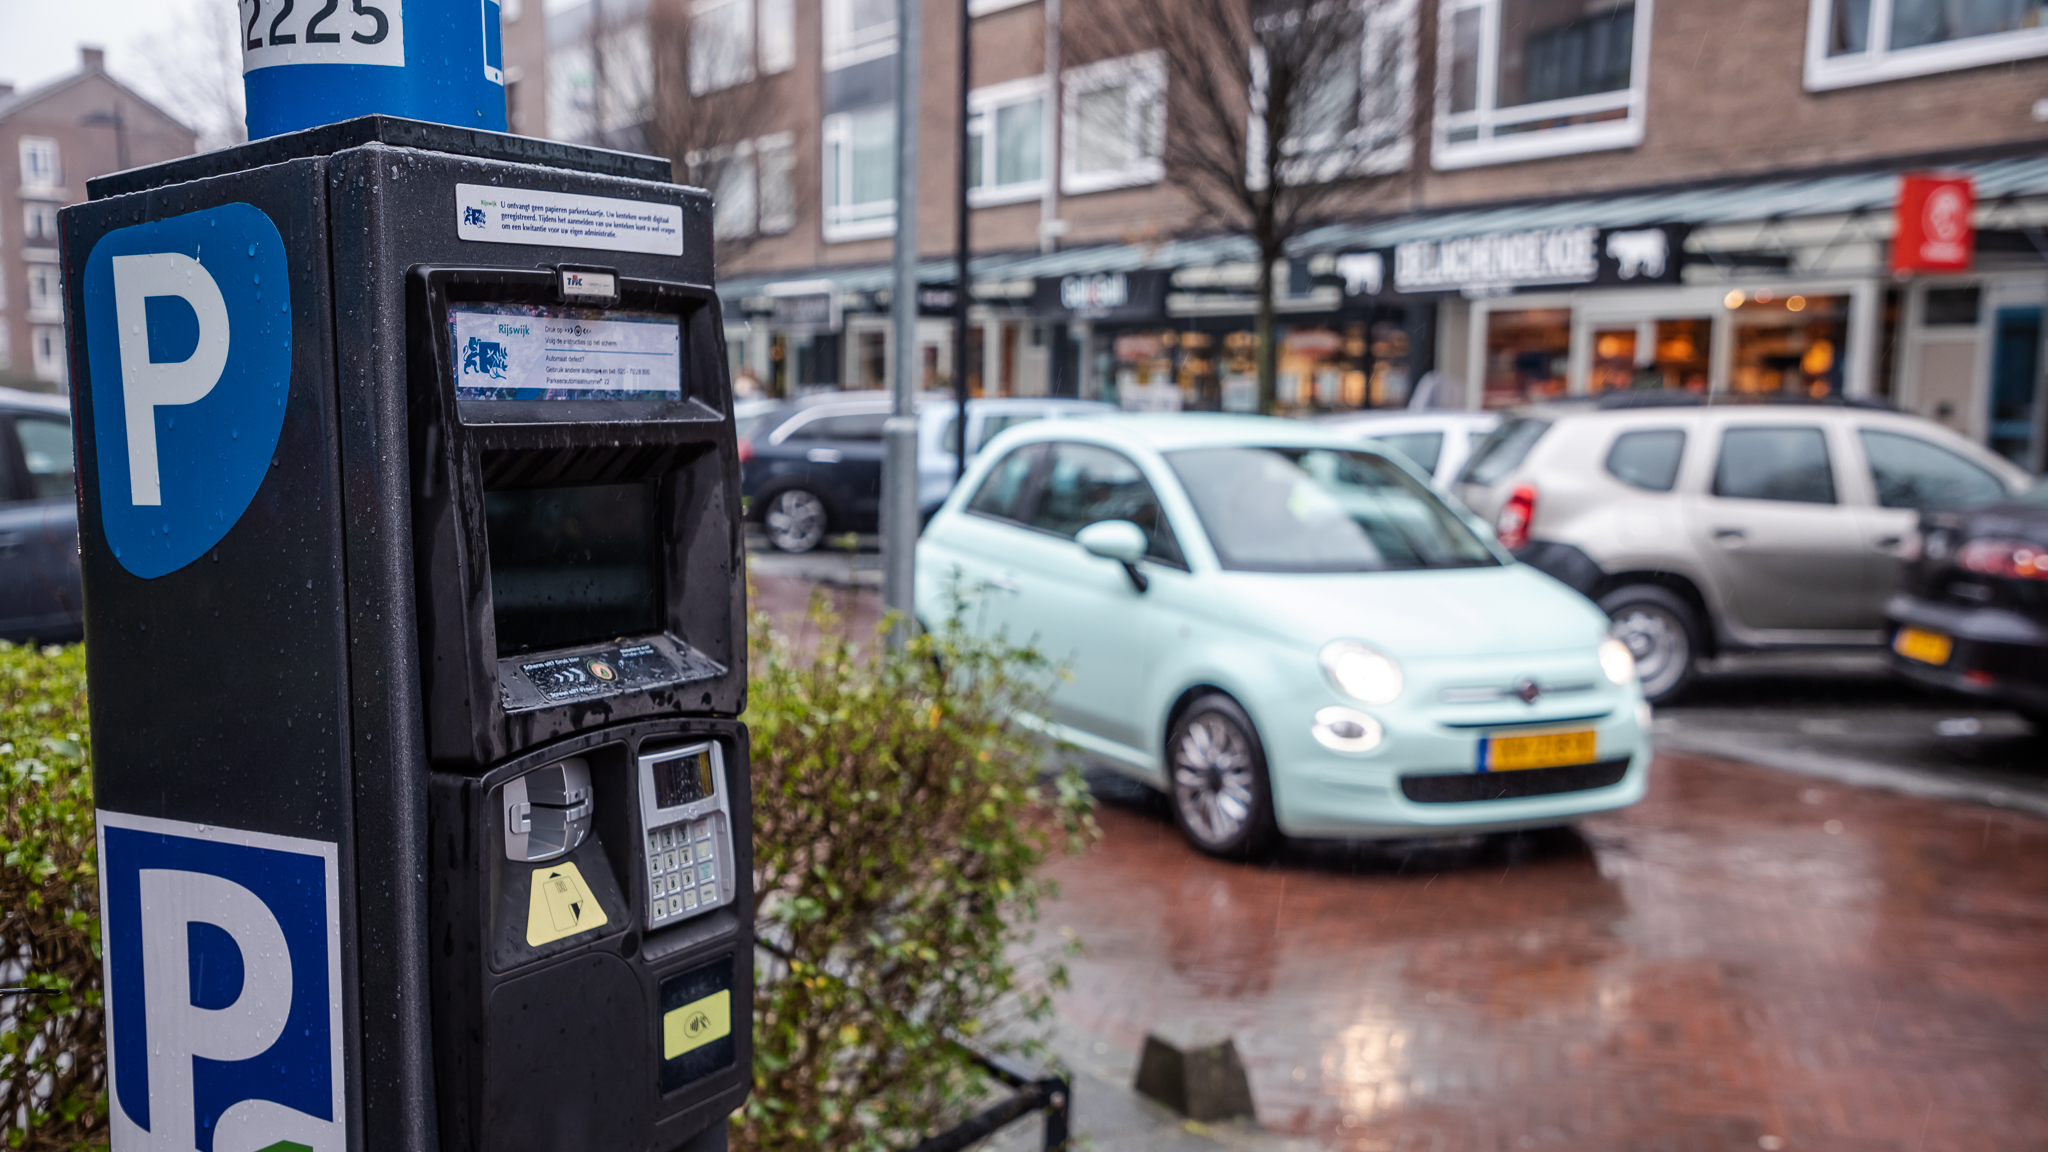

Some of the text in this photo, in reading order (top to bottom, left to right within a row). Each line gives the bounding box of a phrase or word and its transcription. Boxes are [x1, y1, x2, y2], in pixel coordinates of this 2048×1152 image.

[247, 0, 389, 51] 2225
[501, 212, 537, 222] geregistreerd.
[538, 214, 557, 223] Tijdens
[568, 216, 594, 225] aanmelden
[614, 221, 635, 230] kenteken
[507, 202, 530, 212] ontvangt
[545, 205, 567, 214] papieren
[616, 211, 637, 220] kenteken
[653, 215, 669, 225] digitaal
[523, 223, 546, 232] kwitantie
[570, 227, 583, 236] eigen
[584, 229, 617, 238] administratie.
[498, 324, 530, 337] Rijswijk
[112, 252, 230, 506] P
[666, 836, 671, 844] 2
[672, 899, 677, 908] 0
[140, 868, 293, 1152] P
